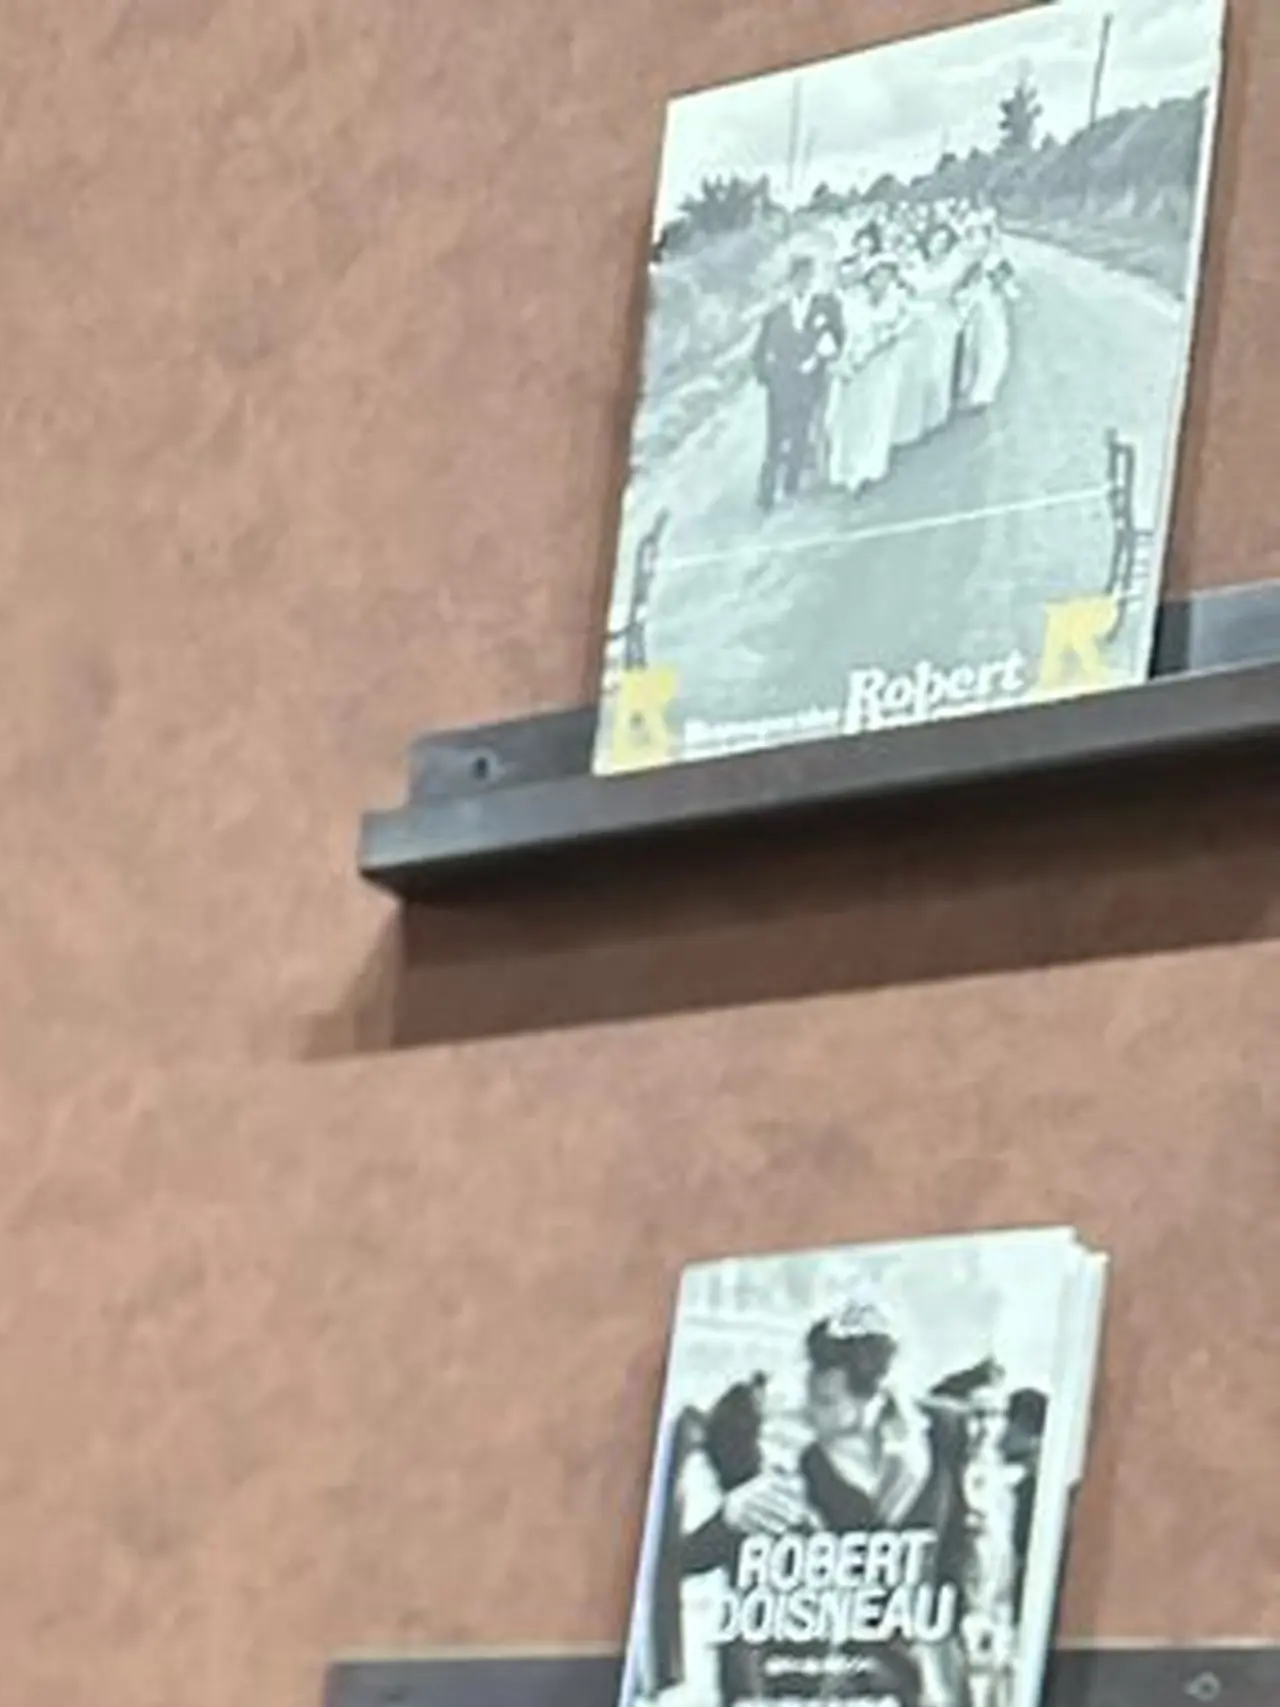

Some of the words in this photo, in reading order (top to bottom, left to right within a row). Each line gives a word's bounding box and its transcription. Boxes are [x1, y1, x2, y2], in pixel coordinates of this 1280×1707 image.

[842, 648, 1026, 732] Robert
[738, 1529, 938, 1591] ROBERT
[711, 1583, 956, 1645] DOISNEAU
